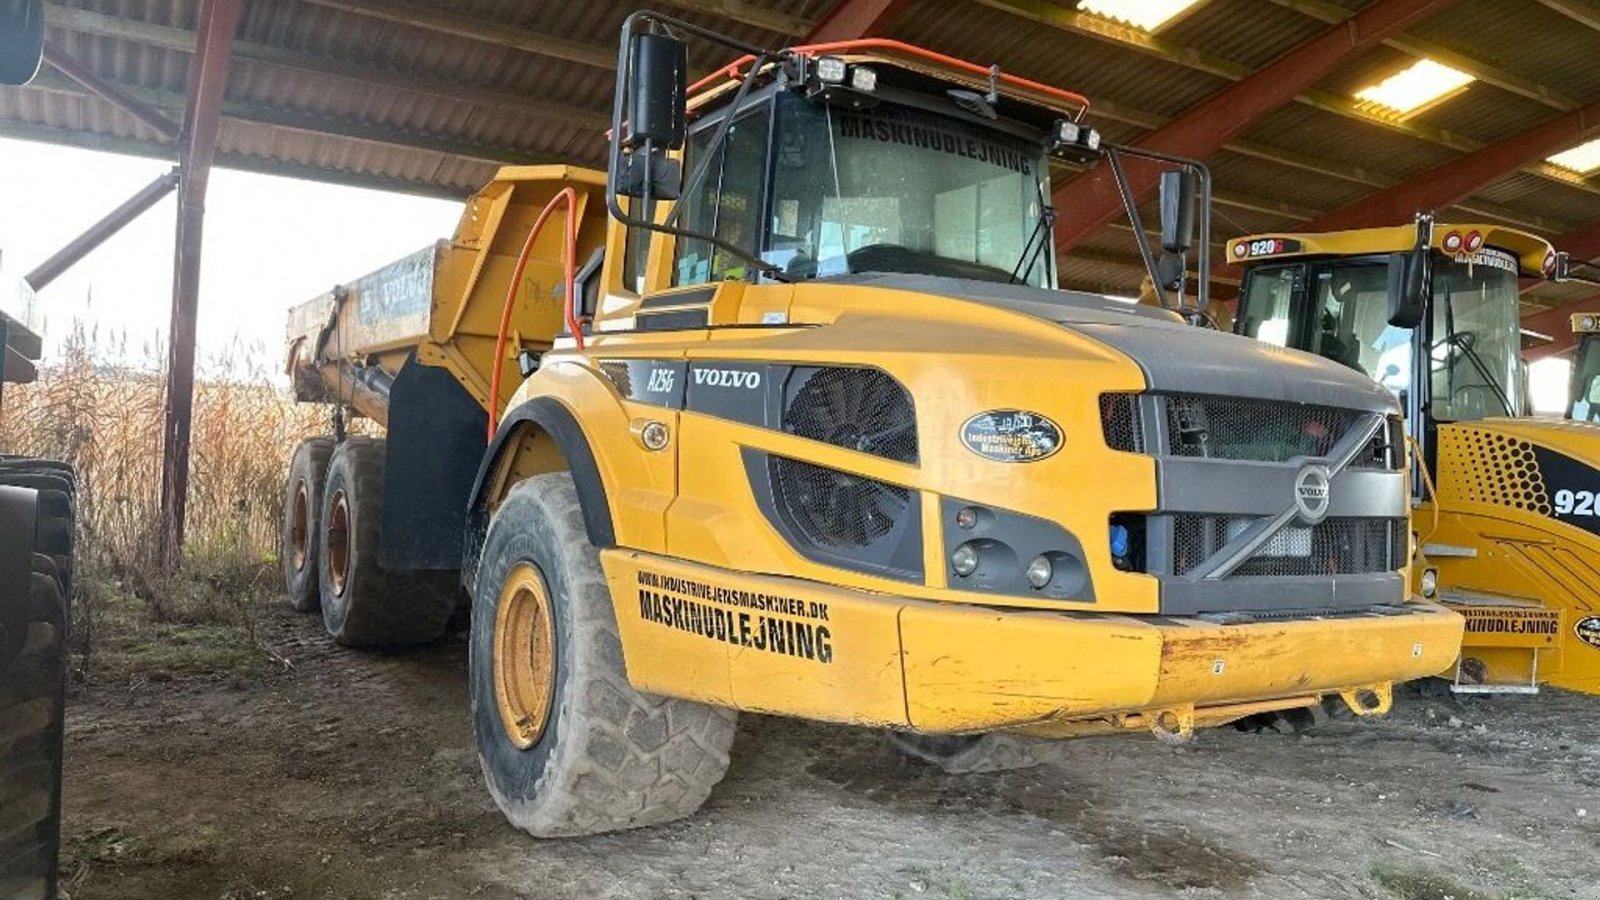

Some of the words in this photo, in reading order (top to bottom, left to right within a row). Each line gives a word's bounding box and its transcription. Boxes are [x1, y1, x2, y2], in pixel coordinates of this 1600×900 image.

[840, 115, 1031, 176] MASKINUDLEJNING
[647, 368, 675, 392] A25G
[694, 368, 761, 389] VOLVO
[1298, 487, 1327, 497] VOLV
[637, 570, 829, 621] WWW.INDUSTRIVEJENSMASKINER.DK
[639, 589, 833, 664] MASKINUDLEJNING
[1464, 618, 1558, 634] KINUDLEJNING
